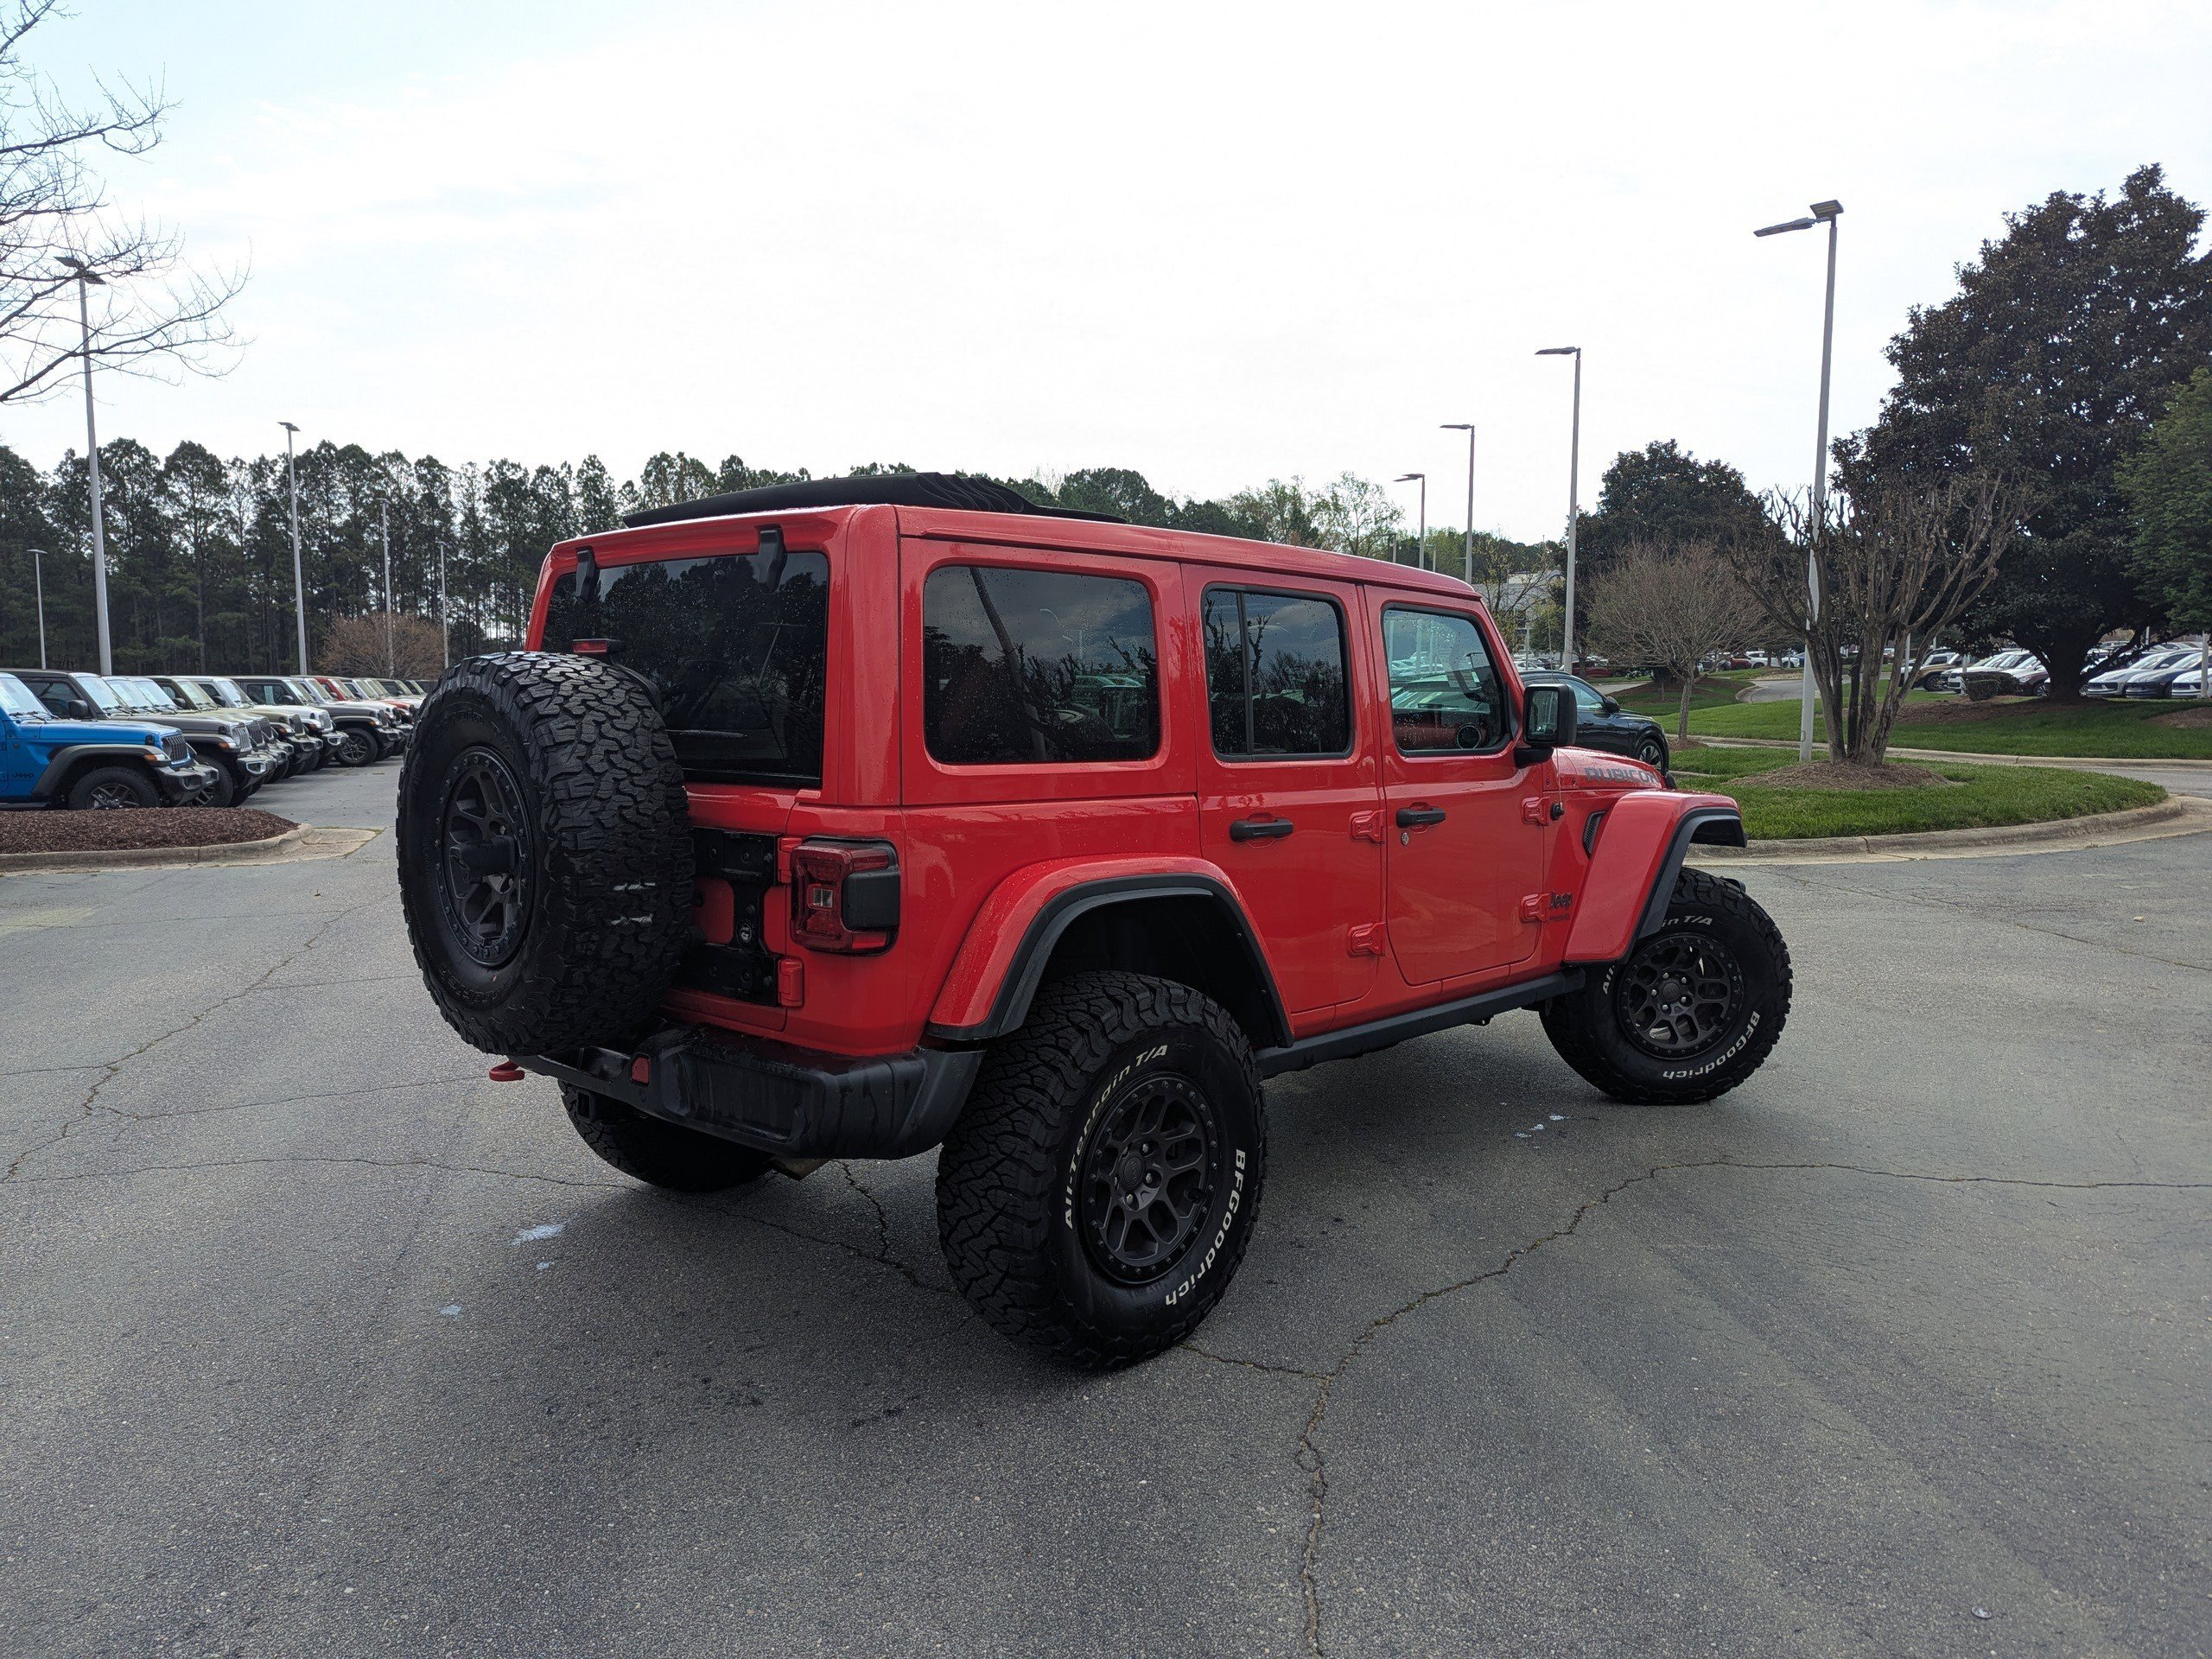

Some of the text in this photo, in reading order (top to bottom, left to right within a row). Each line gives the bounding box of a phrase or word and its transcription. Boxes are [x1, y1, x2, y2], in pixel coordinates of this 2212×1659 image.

[1585, 766, 1659, 783] RUBICON
[1683, 915, 1713, 926] T/A
[1662, 1010, 1761, 1080] BFGoodrich
[1065, 1044, 1168, 1230] All-Terrain T/A
[1165, 1148, 1245, 1306] BFGoodrich
